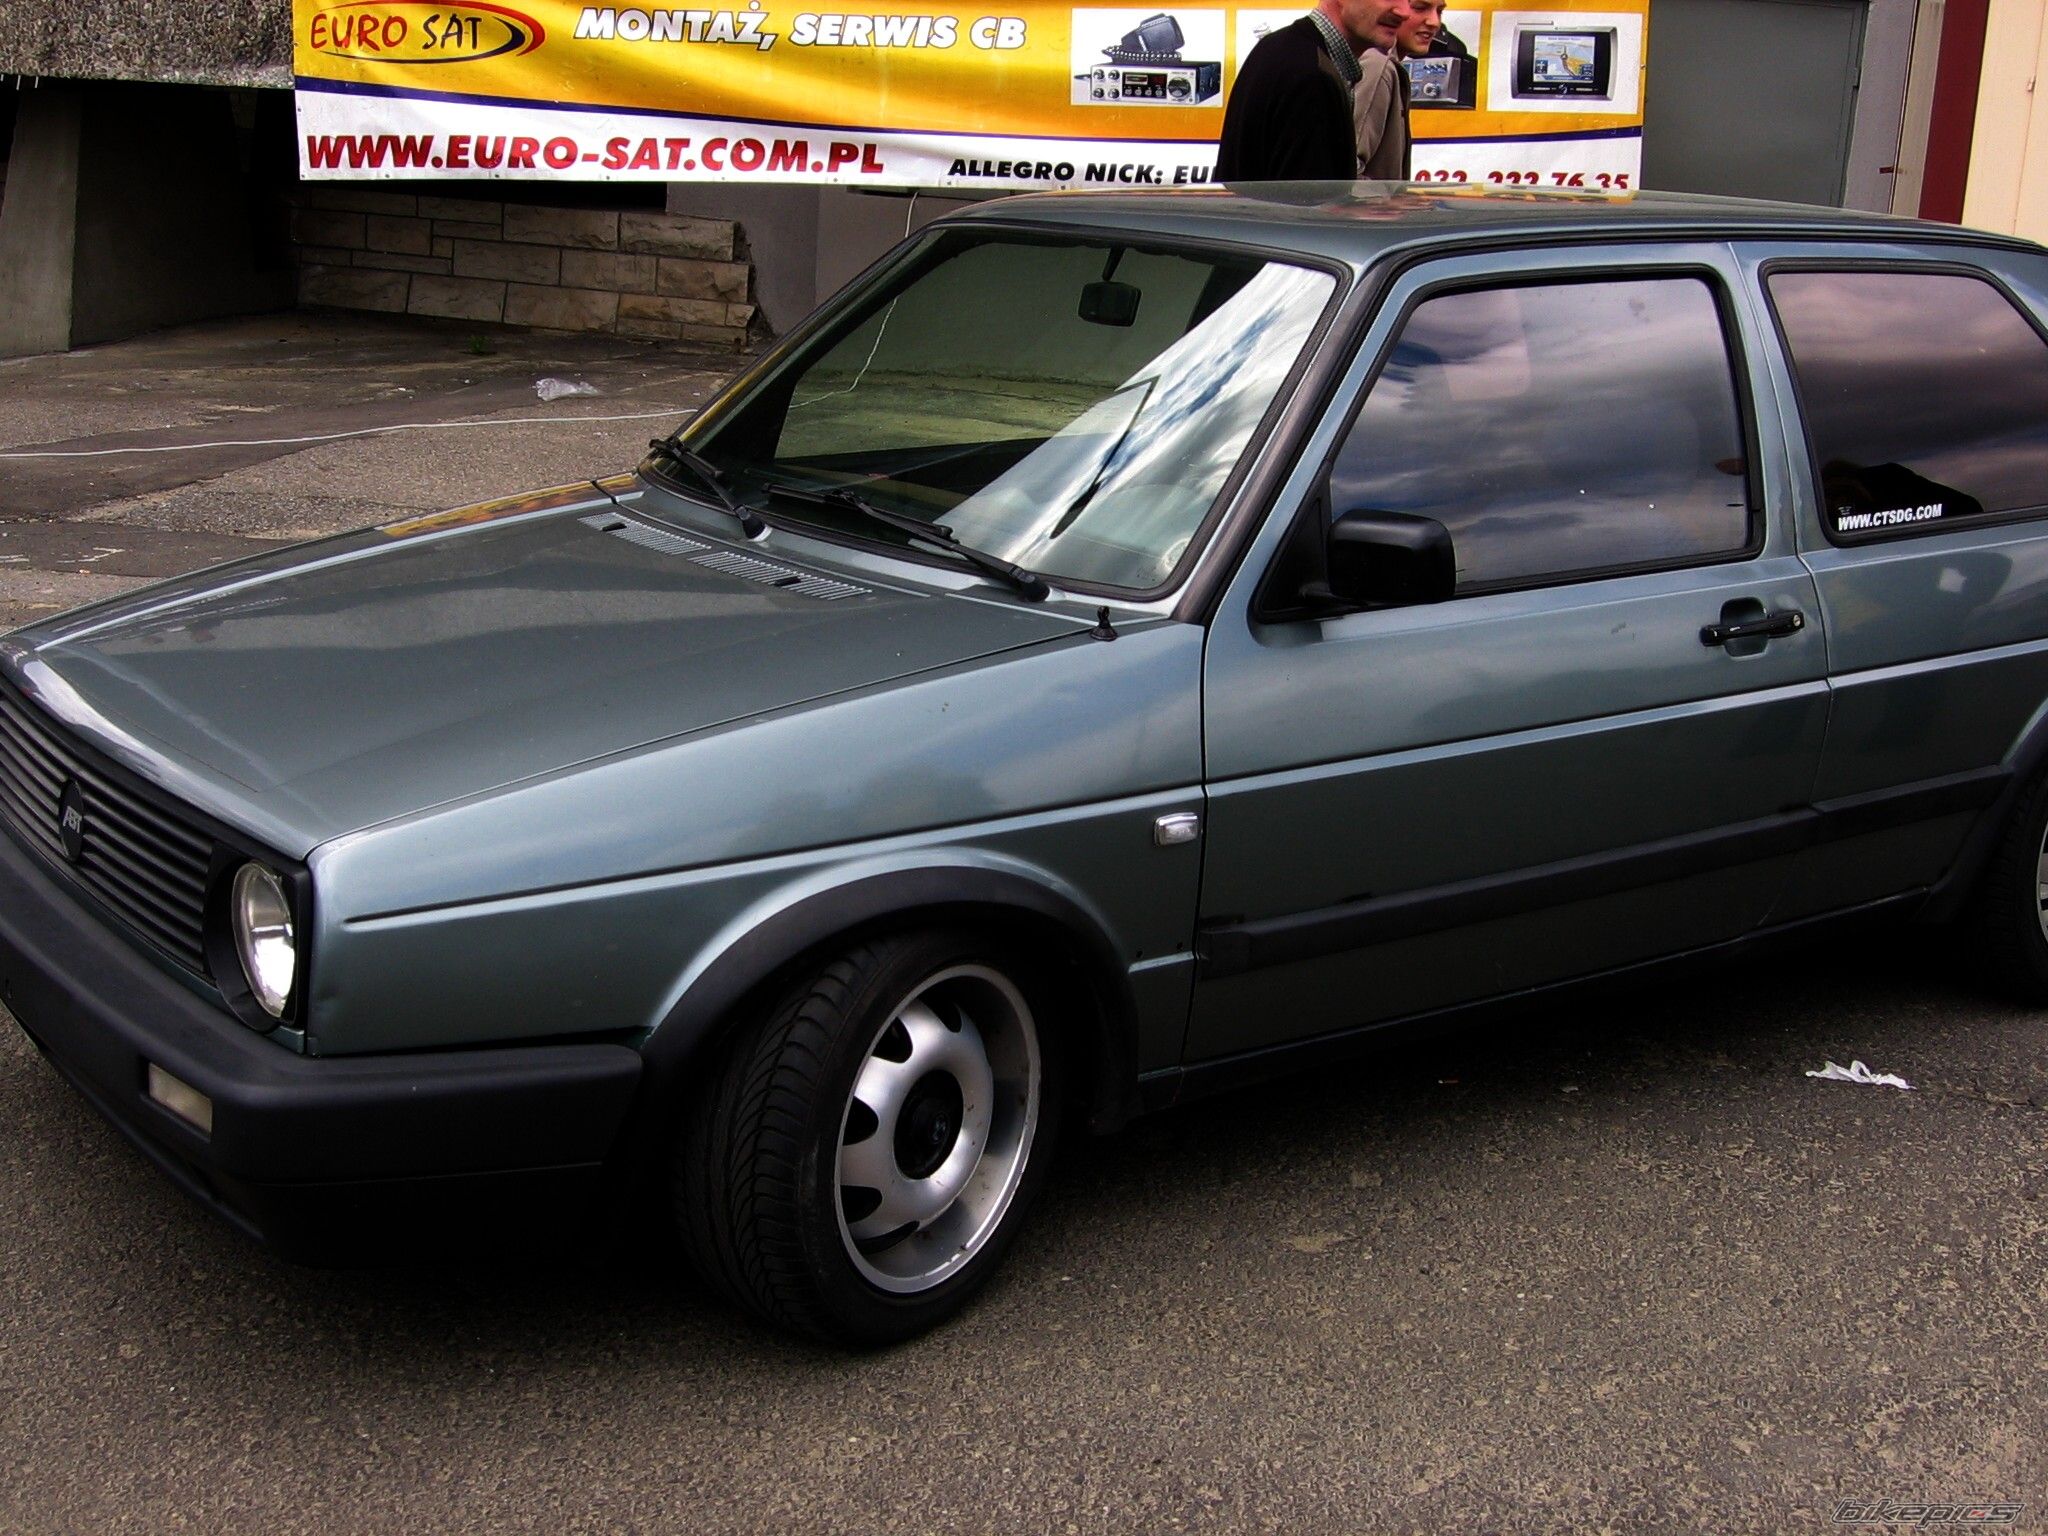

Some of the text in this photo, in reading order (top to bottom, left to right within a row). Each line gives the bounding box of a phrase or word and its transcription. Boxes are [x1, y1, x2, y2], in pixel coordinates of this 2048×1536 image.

[310, 13, 482, 52] EURO SAT
[574, 1, 1028, 51] MONTAŻ, SERWIS CB
[306, 135, 885, 174] WWW.EURO-SAT.COM.PL
[948, 158, 1075, 182] ALLEGRO
[1085, 162, 1164, 184] NICK:
